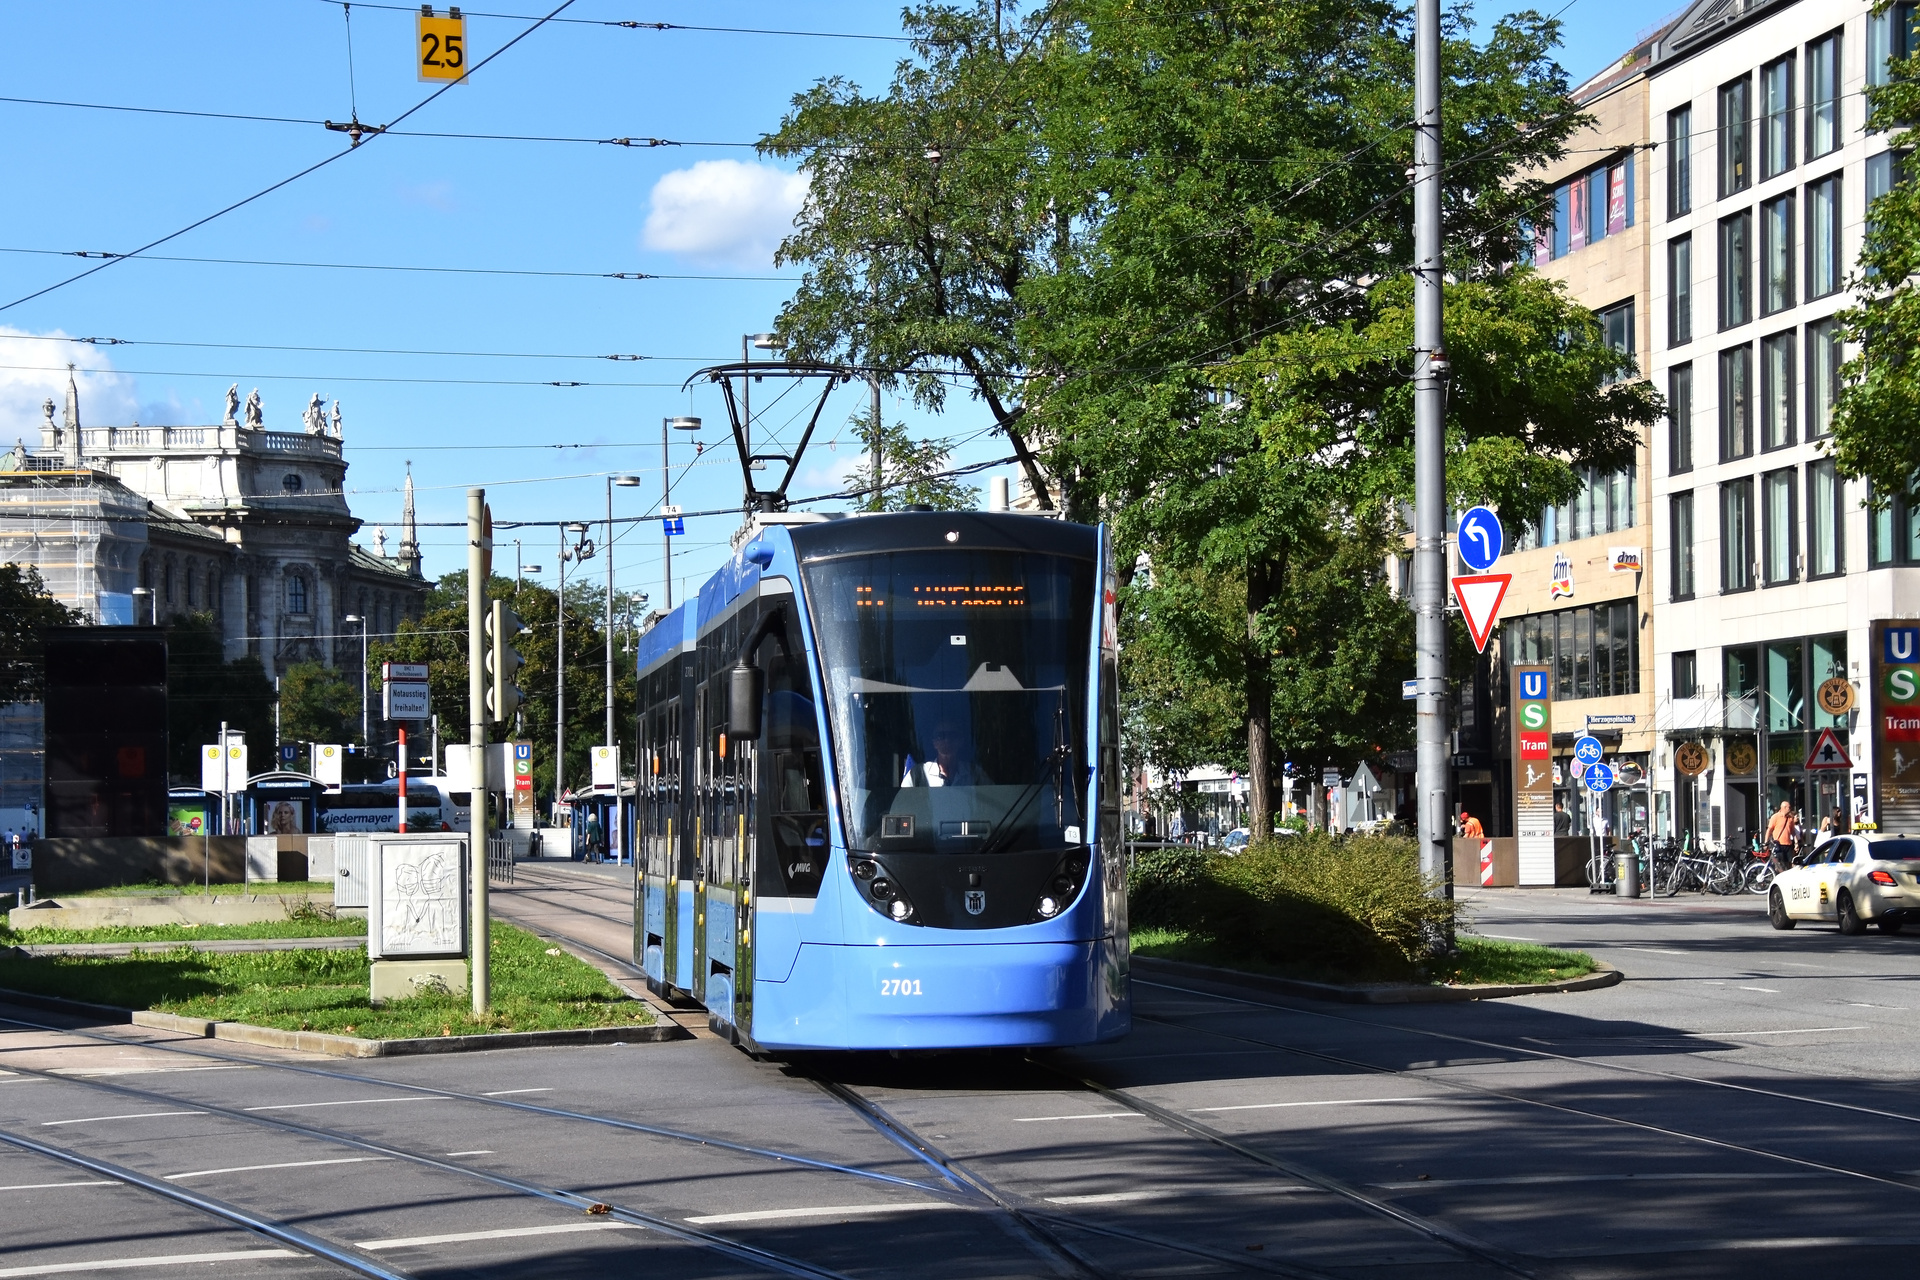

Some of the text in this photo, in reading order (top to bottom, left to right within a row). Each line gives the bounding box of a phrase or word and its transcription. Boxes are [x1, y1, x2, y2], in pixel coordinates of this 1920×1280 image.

[422, 33, 463, 68] 2,5
[1618, 551, 1637, 563] dm
[1553, 555, 1568, 580] dm
[1891, 632, 1912, 659] U
[1525, 674, 1541, 696] U
[1890, 670, 1913, 700] S
[393, 690, 426, 700] Notausstieg
[394, 704, 425, 712] freihalten!
[1524, 704, 1544, 728] S
[1885, 716, 1920, 730] Tram
[518, 746, 528, 757] U
[1521, 740, 1547, 751] Tram
[284, 748, 294, 759] U
[518, 761, 529, 774] S
[1067, 830, 1077, 838] T3
[794, 863, 811, 873] MVG
[1791, 884, 1811, 900] taxi.eu
[880, 979, 923, 996] 2701
